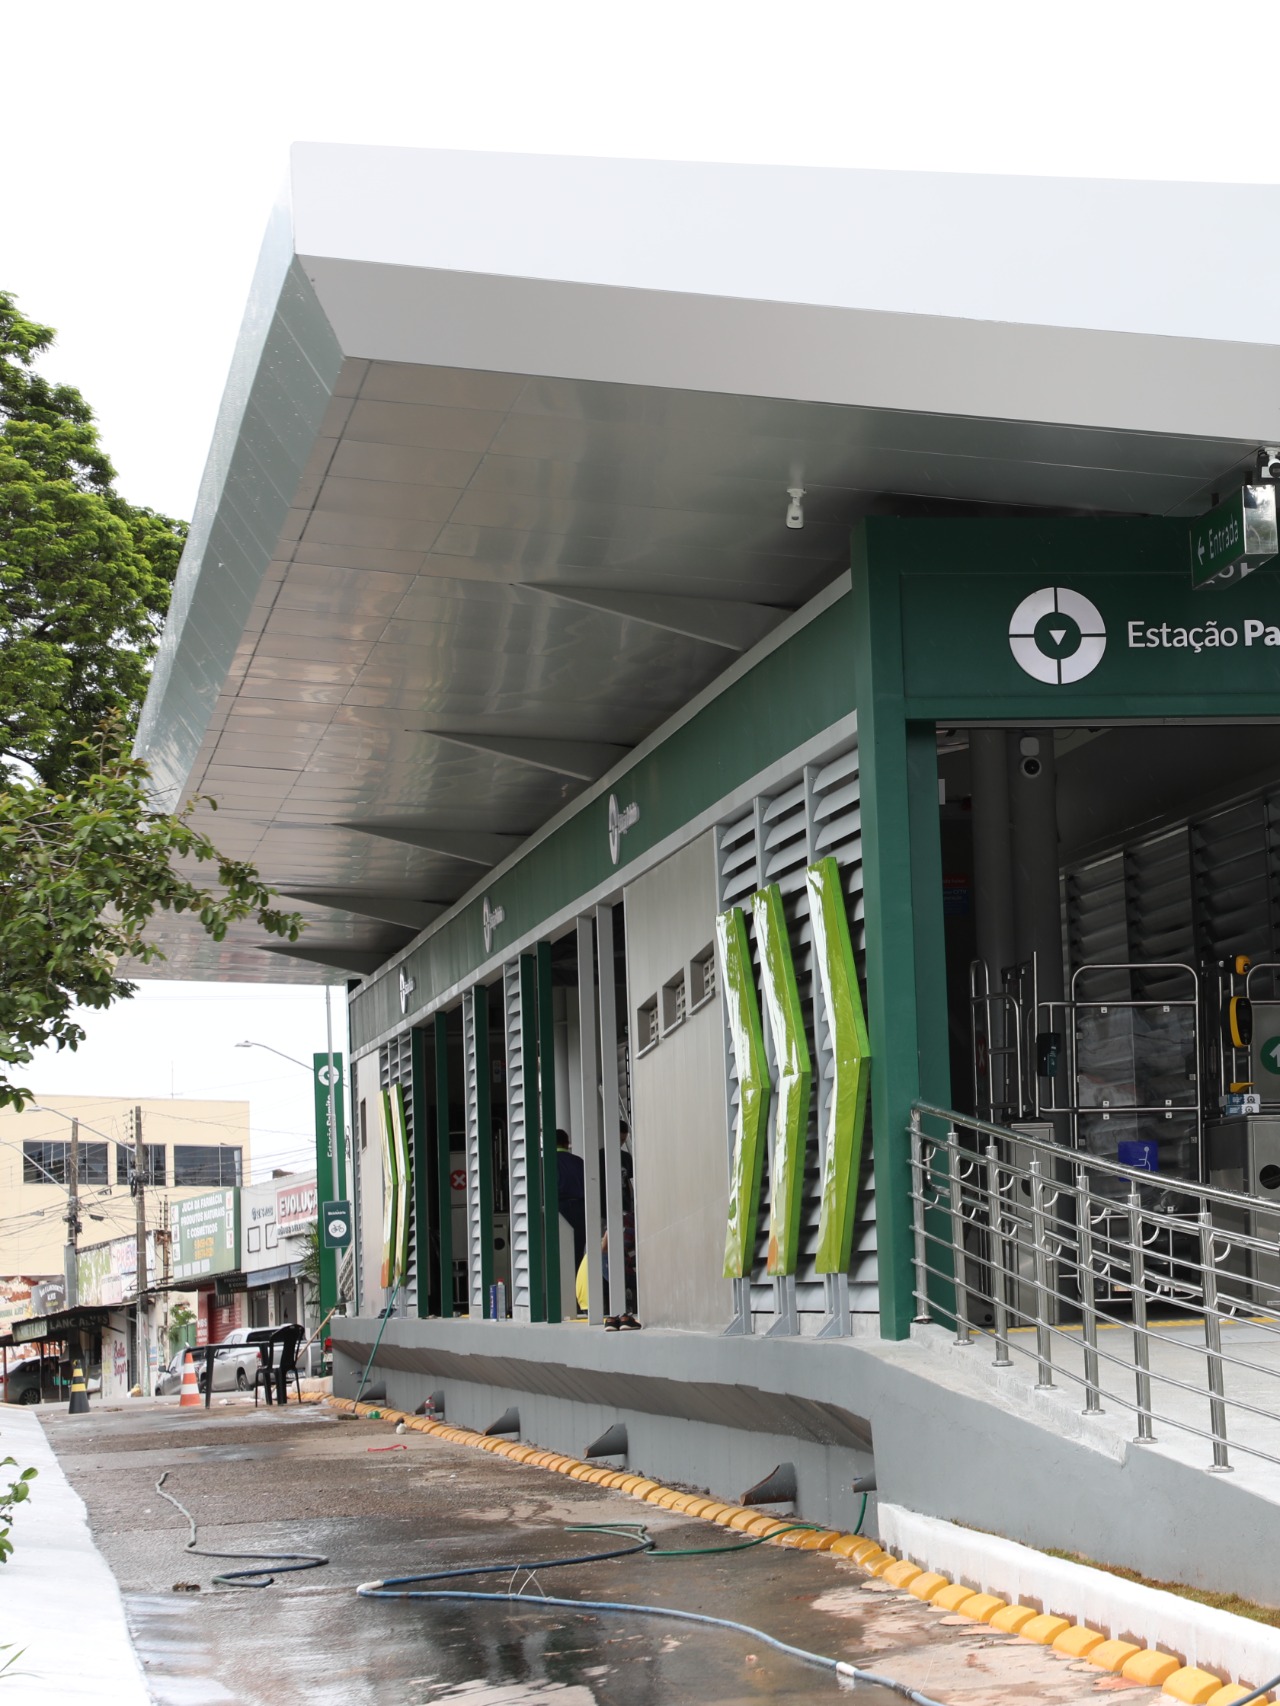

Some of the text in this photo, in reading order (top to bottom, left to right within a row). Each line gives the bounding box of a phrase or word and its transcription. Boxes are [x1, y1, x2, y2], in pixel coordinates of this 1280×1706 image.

[1208, 513, 1239, 559] Entrada
[1127, 620, 1239, 654] Estação
[181, 1193, 223, 1213] JUCA DA FARMÁCIA
[181, 1206, 226, 1227] PRODUTOS NATURAIS
[186, 1222, 218, 1239] E COSMÉTICOS
